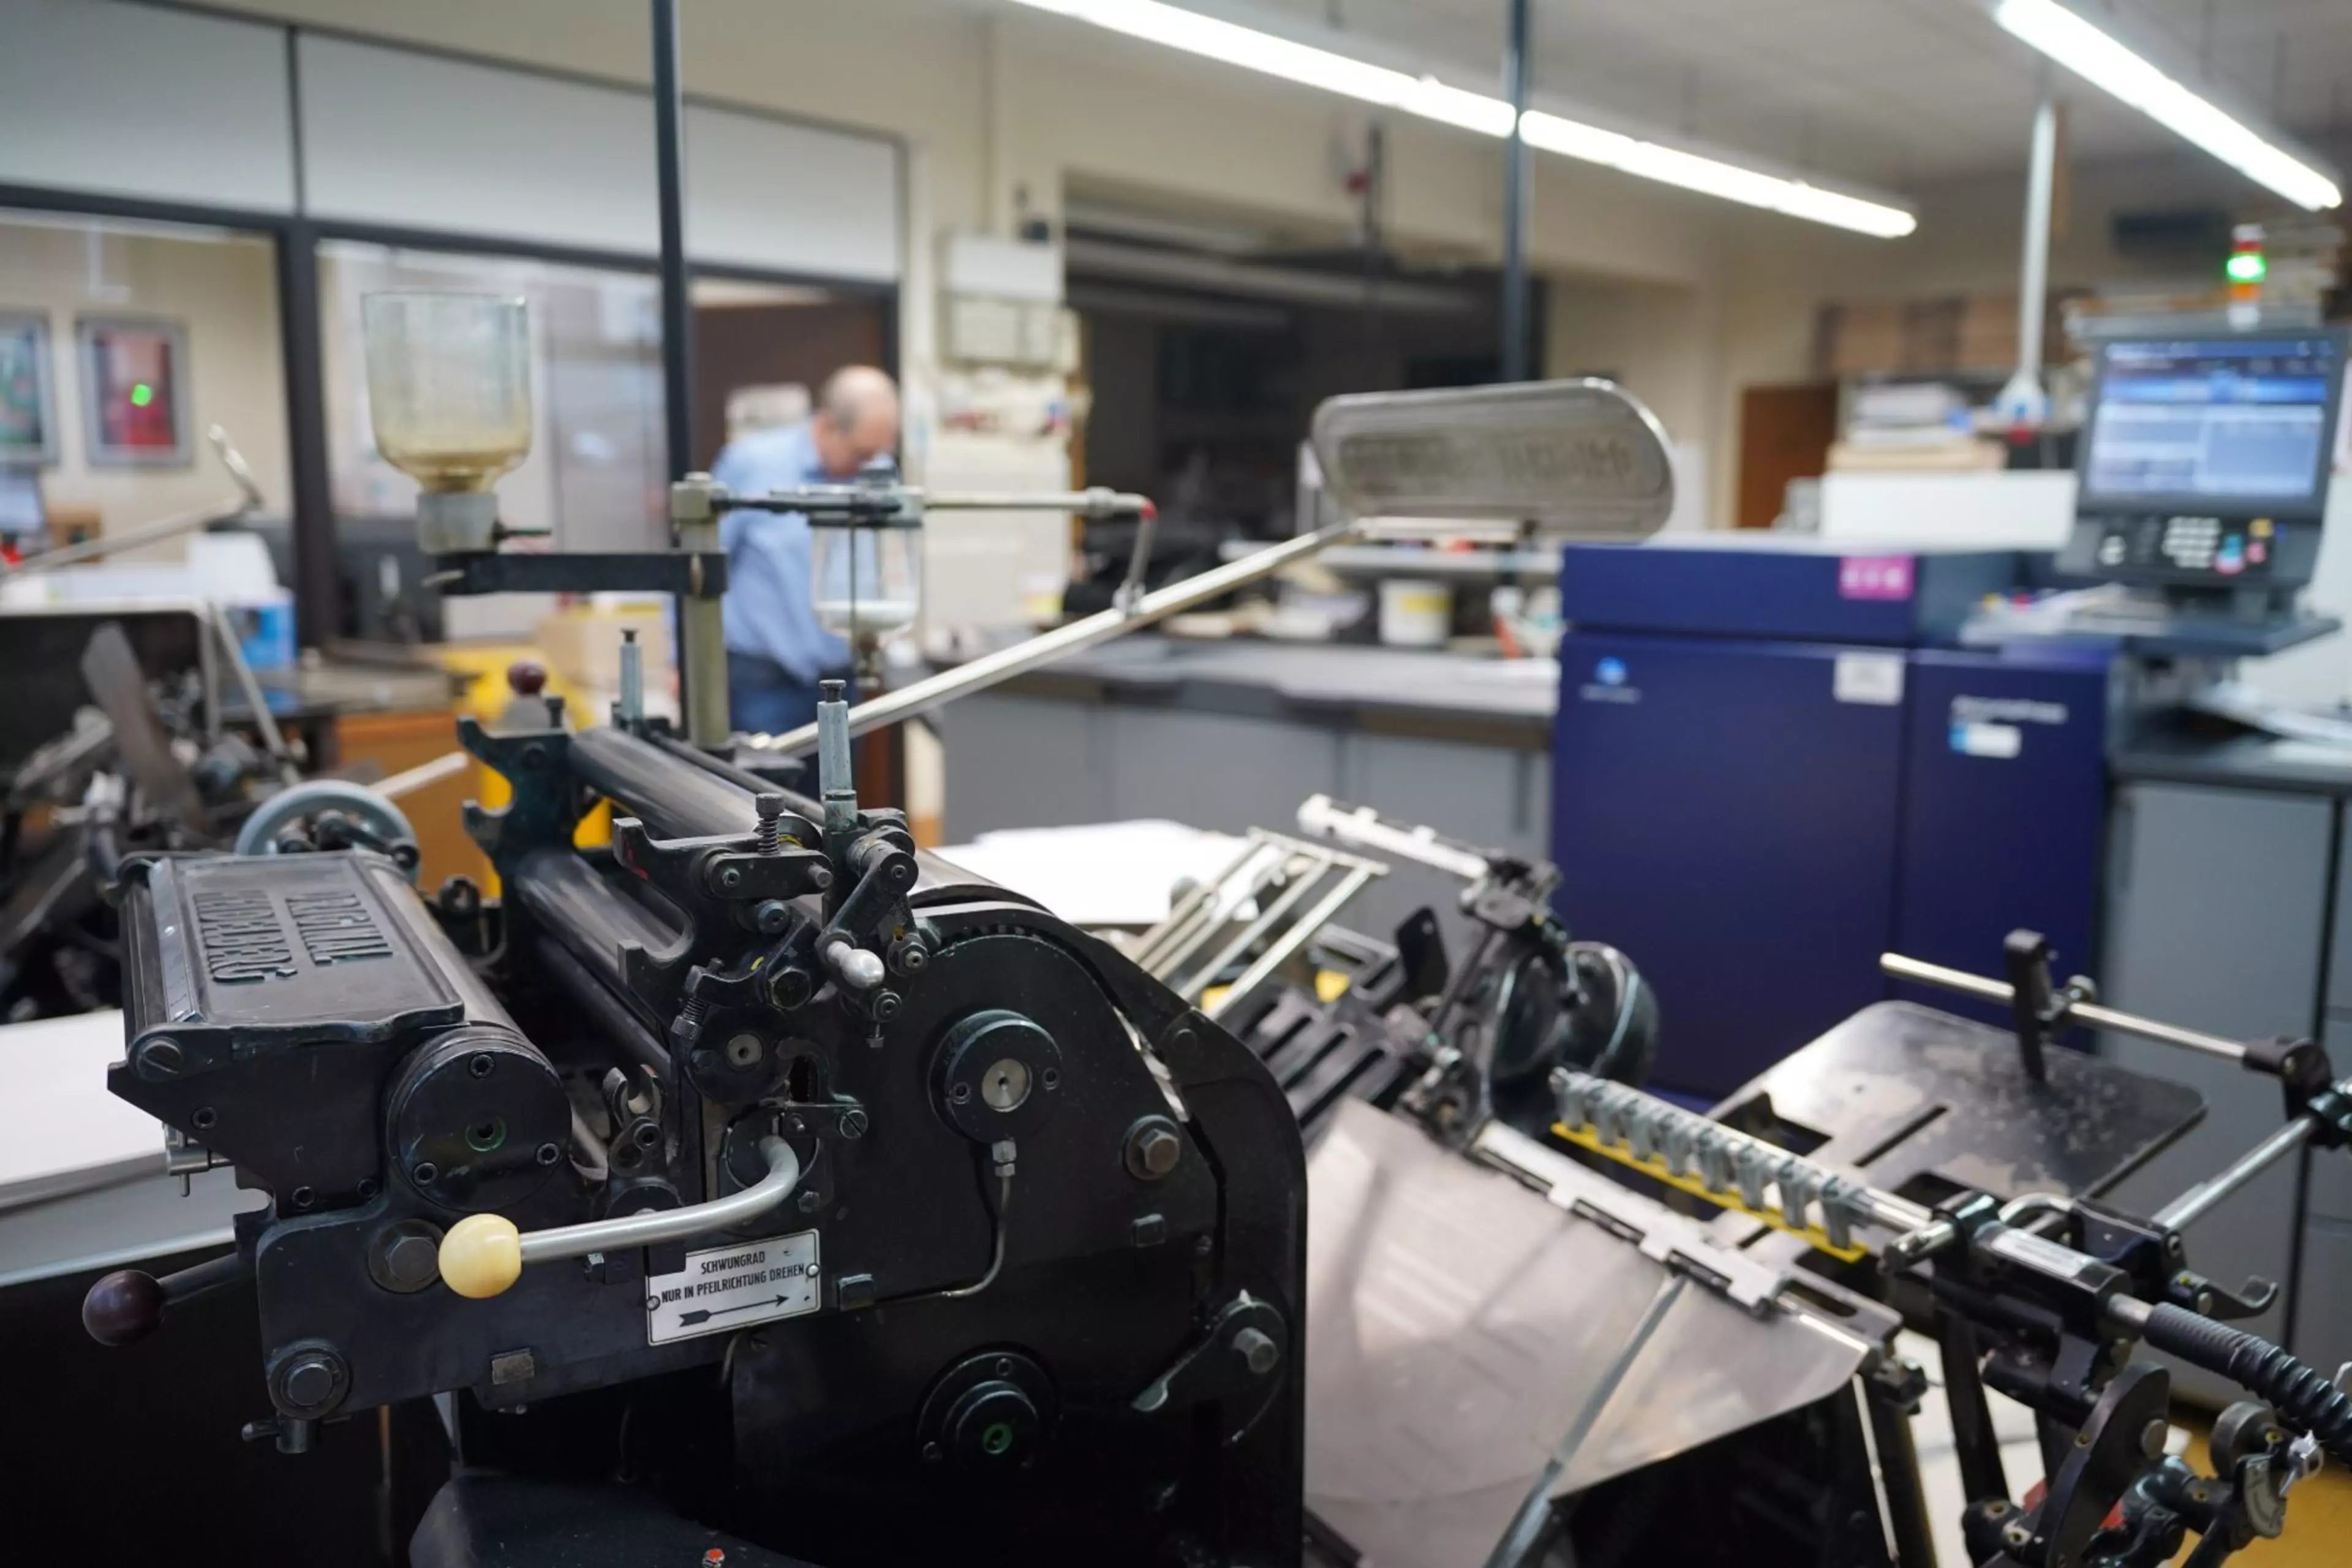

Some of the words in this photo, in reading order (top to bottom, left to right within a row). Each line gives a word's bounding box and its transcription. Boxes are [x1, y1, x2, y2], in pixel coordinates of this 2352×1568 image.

[701, 1251, 765, 1274] SCHWUNGRAD
[662, 1289, 681, 1303] NUR
[684, 1286, 694, 1298] IN
[697, 1271, 766, 1295] PFEILRICHTUNG
[769, 1264, 805, 1281] DREHEN
